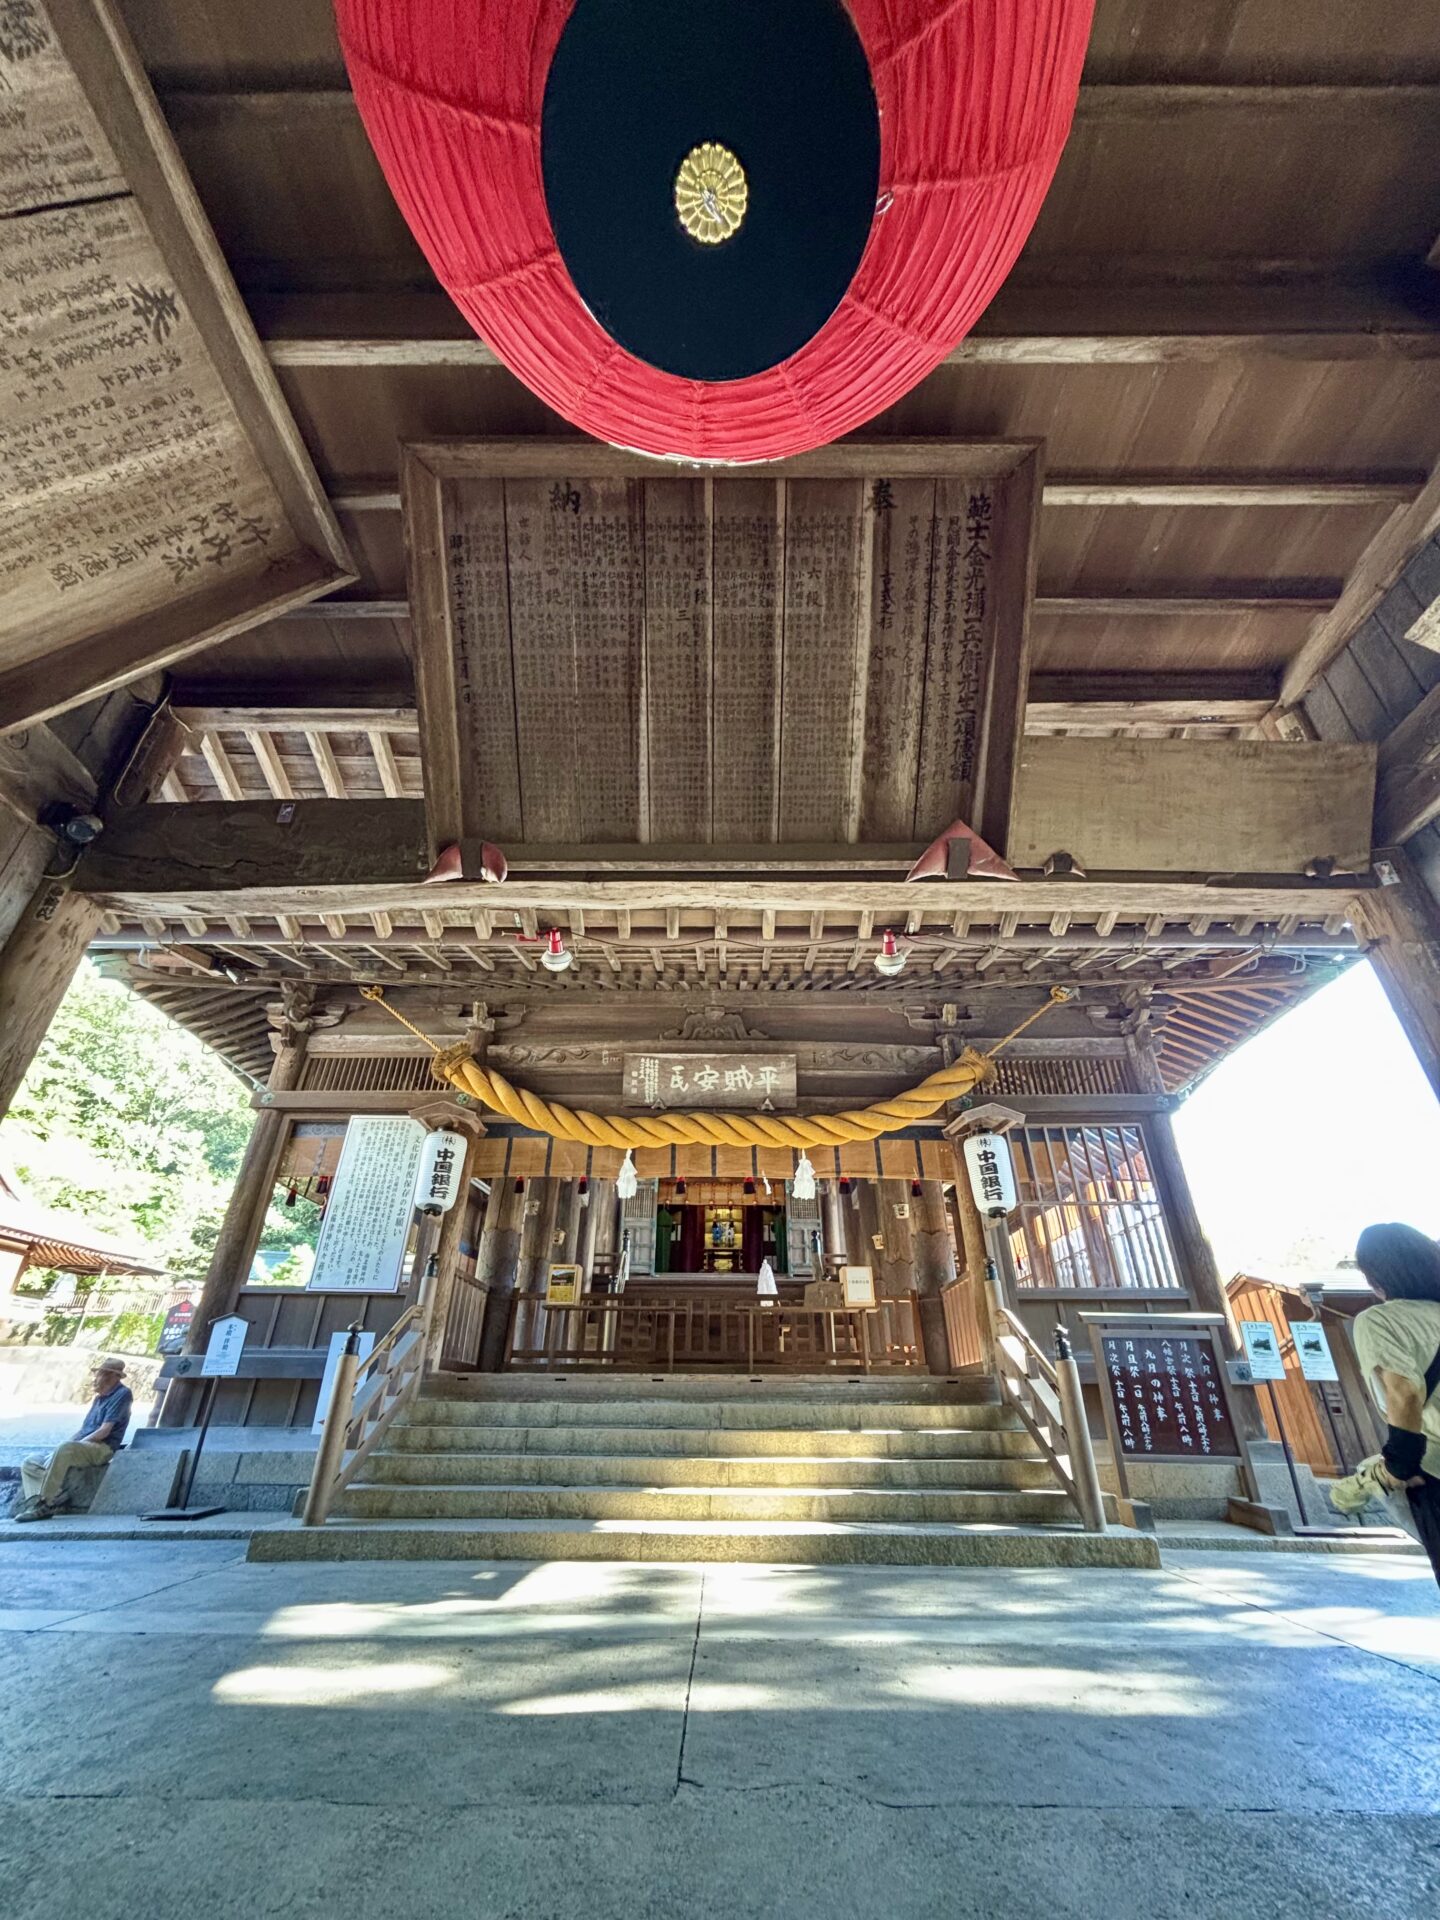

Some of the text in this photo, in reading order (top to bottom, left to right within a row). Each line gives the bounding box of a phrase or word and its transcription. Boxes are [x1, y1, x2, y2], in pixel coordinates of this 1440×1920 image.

[126, 281, 180, 346] 奉
[549, 481, 581, 515] 納
[865, 479, 897, 516] 奉
